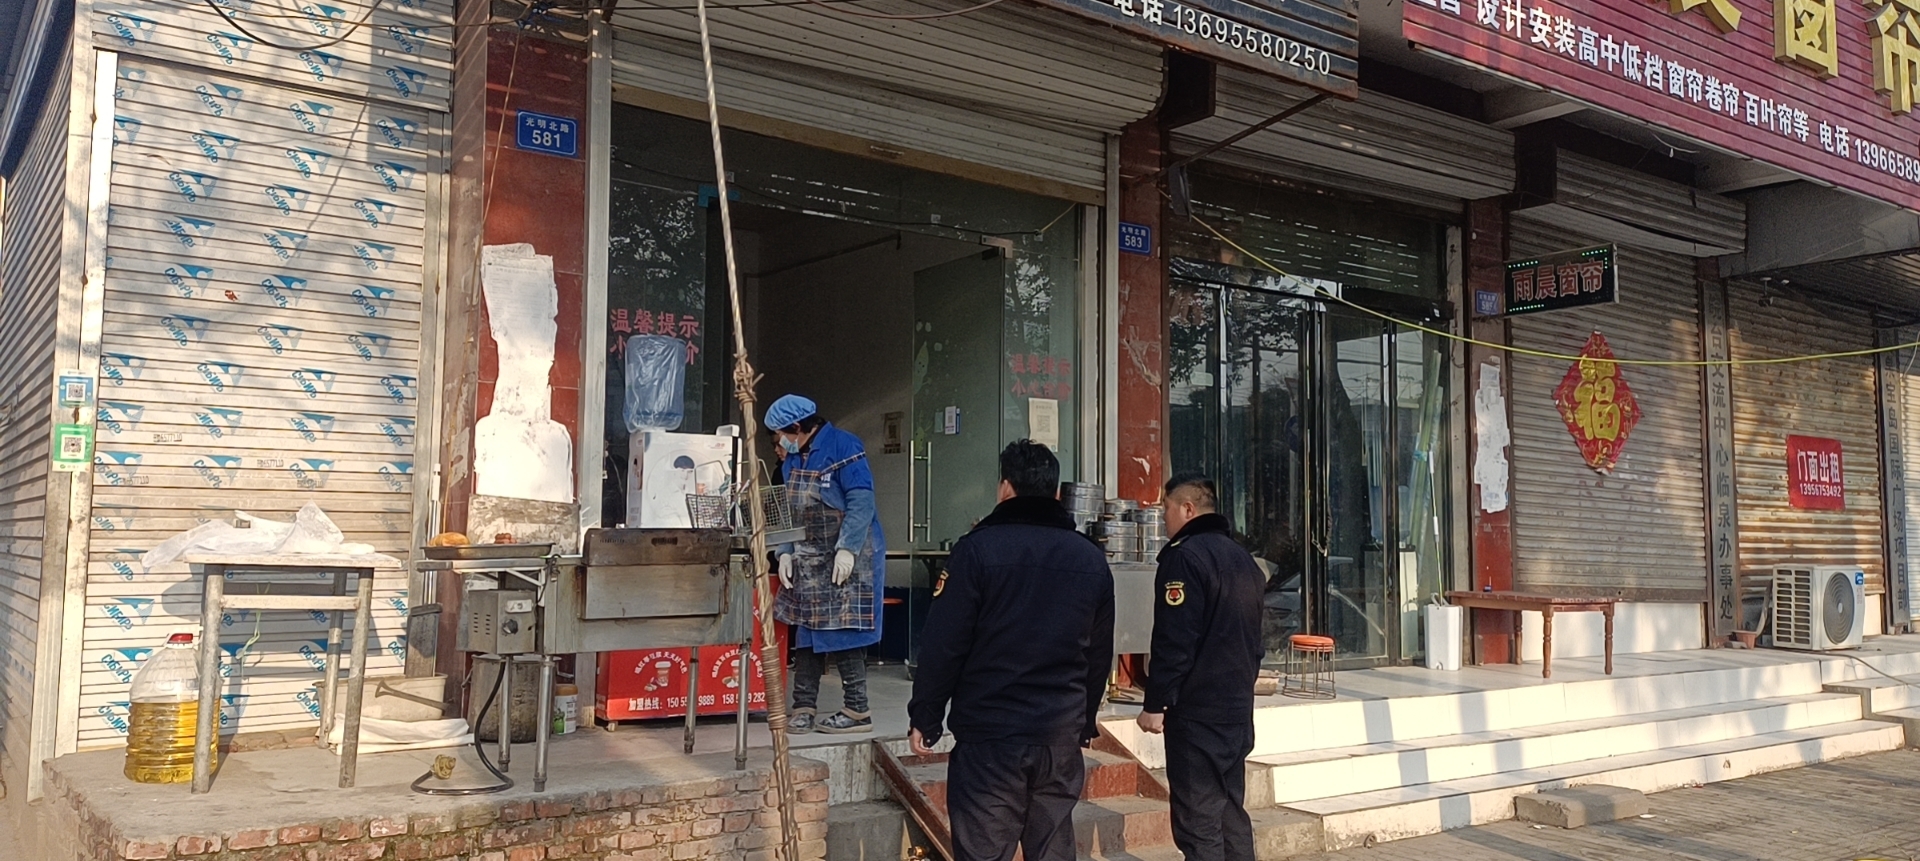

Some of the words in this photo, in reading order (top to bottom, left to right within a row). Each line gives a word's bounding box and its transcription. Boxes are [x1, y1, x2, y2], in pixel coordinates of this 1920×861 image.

[1174, 4, 1330, 75] 13695580250
[526, 117, 569, 133] 光明北路
[532, 130, 560, 148] 581
[1819, 120, 1849, 158] 电话
[1855, 138, 1920, 184] 13966589
[1125, 235, 1142, 248] 583
[1512, 258, 1604, 303] 雨晨窗帘
[610, 308, 700, 338] 温馨提示
[1574, 354, 1620, 441] 福
[1797, 449, 1840, 483] 门面出租
[1800, 483, 1841, 497] 13956753492
